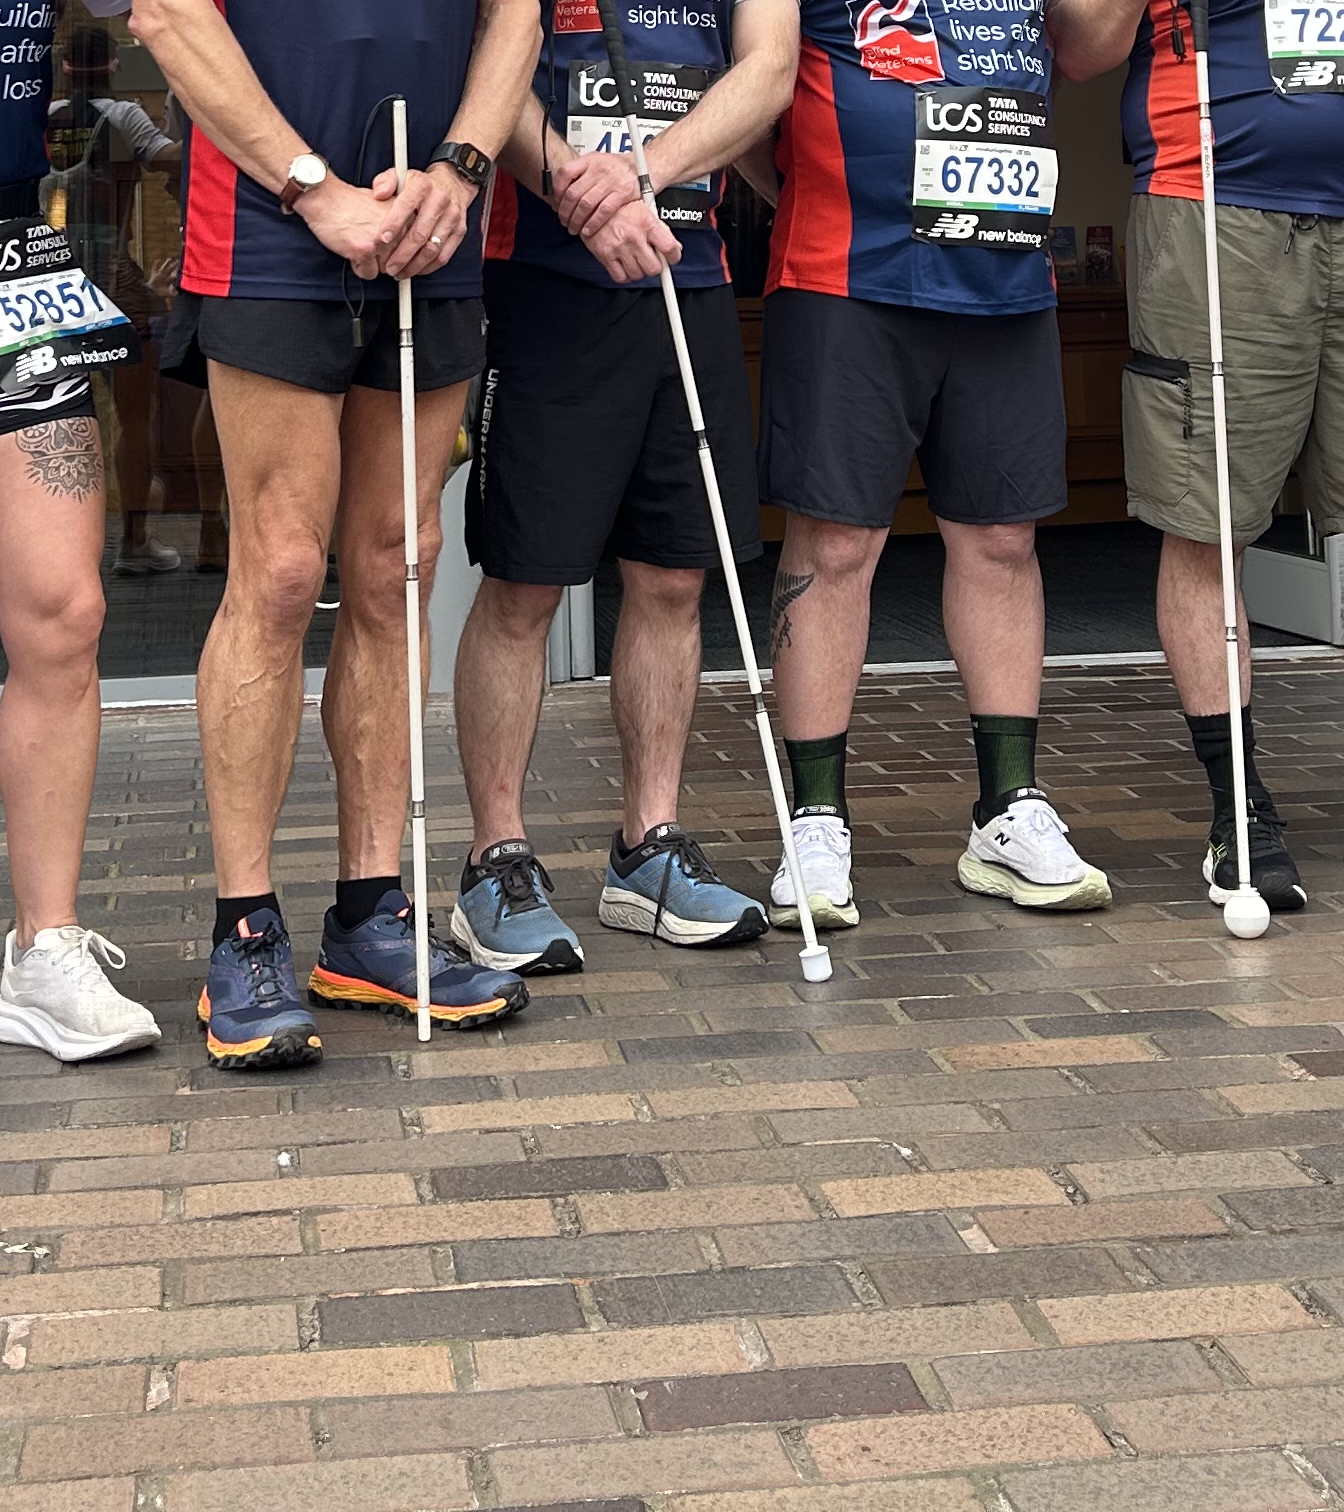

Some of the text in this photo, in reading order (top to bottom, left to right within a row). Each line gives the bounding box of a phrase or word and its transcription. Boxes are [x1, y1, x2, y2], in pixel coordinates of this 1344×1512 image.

[557, 5, 599, 15] Vetera
[628, 5, 716, 29] sight loss
[558, 17, 575, 28] UK
[949, 19, 1005, 42] lives
[957, 49, 1044, 76] sight loss
[3, 74, 42, 100] loss
[644, 73, 676, 85] TATA
[579, 71, 638, 107] tc
[644, 98, 688, 112] SERVICES
[988, 98, 1018, 109] TATA
[926, 96, 982, 133] tcs
[988, 110, 1046, 127] CONSULTANCY
[988, 124, 1031, 136] SERVICES
[942, 155, 1039, 198] 67332
[660, 208, 702, 222] balance
[26, 225, 54, 238] TATA
[978, 230, 1006, 241] new
[26, 248, 72, 268] SERVICES
[481, 368, 500, 434] UNDER
